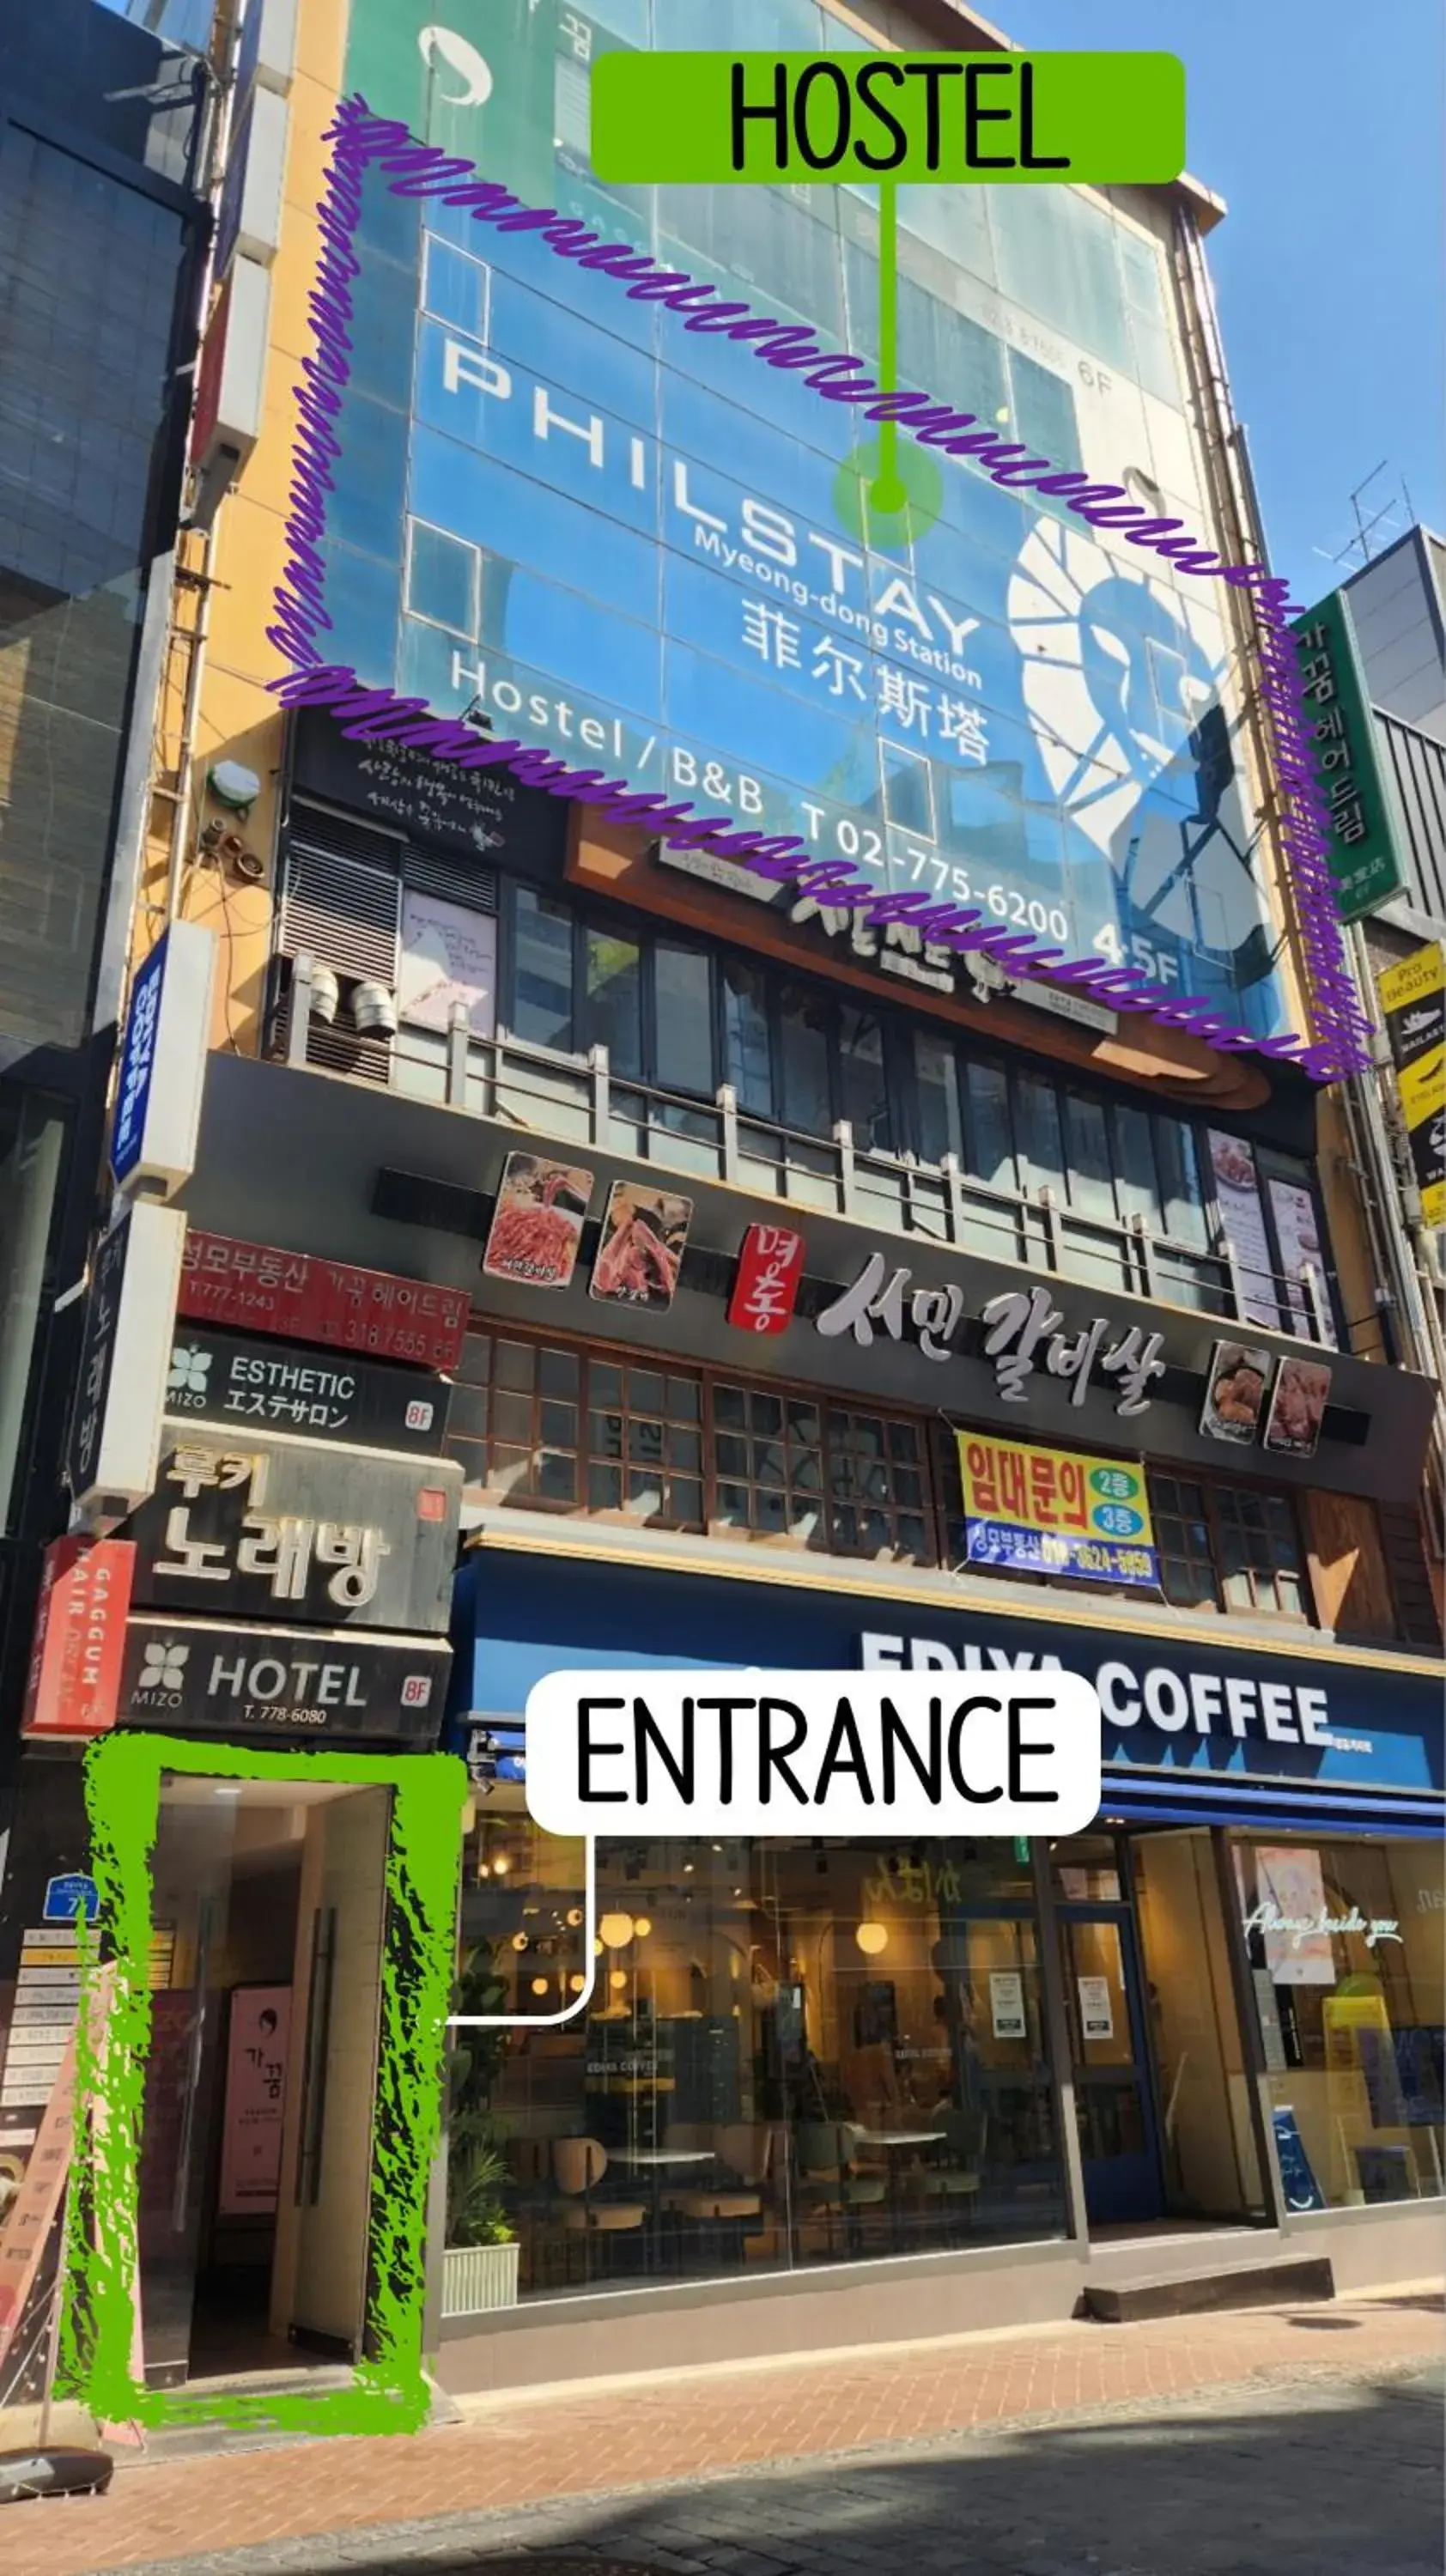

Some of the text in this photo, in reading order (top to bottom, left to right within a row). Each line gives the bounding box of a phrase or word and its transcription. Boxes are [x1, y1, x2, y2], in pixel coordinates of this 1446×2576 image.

[1078, 360, 1114, 398] 6F
[442, 337, 983, 656] PHILSTAY
[693, 523, 982, 691] Myeong-dong Station
[741, 598, 990, 766] 菲尔斯塔
[451, 649, 623, 759] Hostel
[672, 745, 764, 815] B&B
[799, 802, 828, 841] T
[836, 817, 1068, 941] 02-775-6200
[182, 1239, 308, 1294] 성모부동산
[745, 1226, 799, 1332] 명동
[817, 1252, 1165, 1416] 서민 갈비살
[224, 1390, 349, 1429] エステサロン
[230, 1357, 356, 1400] ESTHETIC
[408, 1406, 431, 1425] 8F
[967, 1442, 1131, 1530] 임대문의 2층
[1102, 1507, 1133, 1534] 3층
[68, 1547, 92, 1615] HAIR
[153, 1506, 390, 1607] 노래방
[82, 1567, 112, 1685] GAGGUM
[131, 1691, 183, 1708] MIZO
[207, 1654, 368, 1707] HOTEL
[404, 1680, 428, 1701] 8F
[1097, 1662, 1334, 1747] COFFEE
